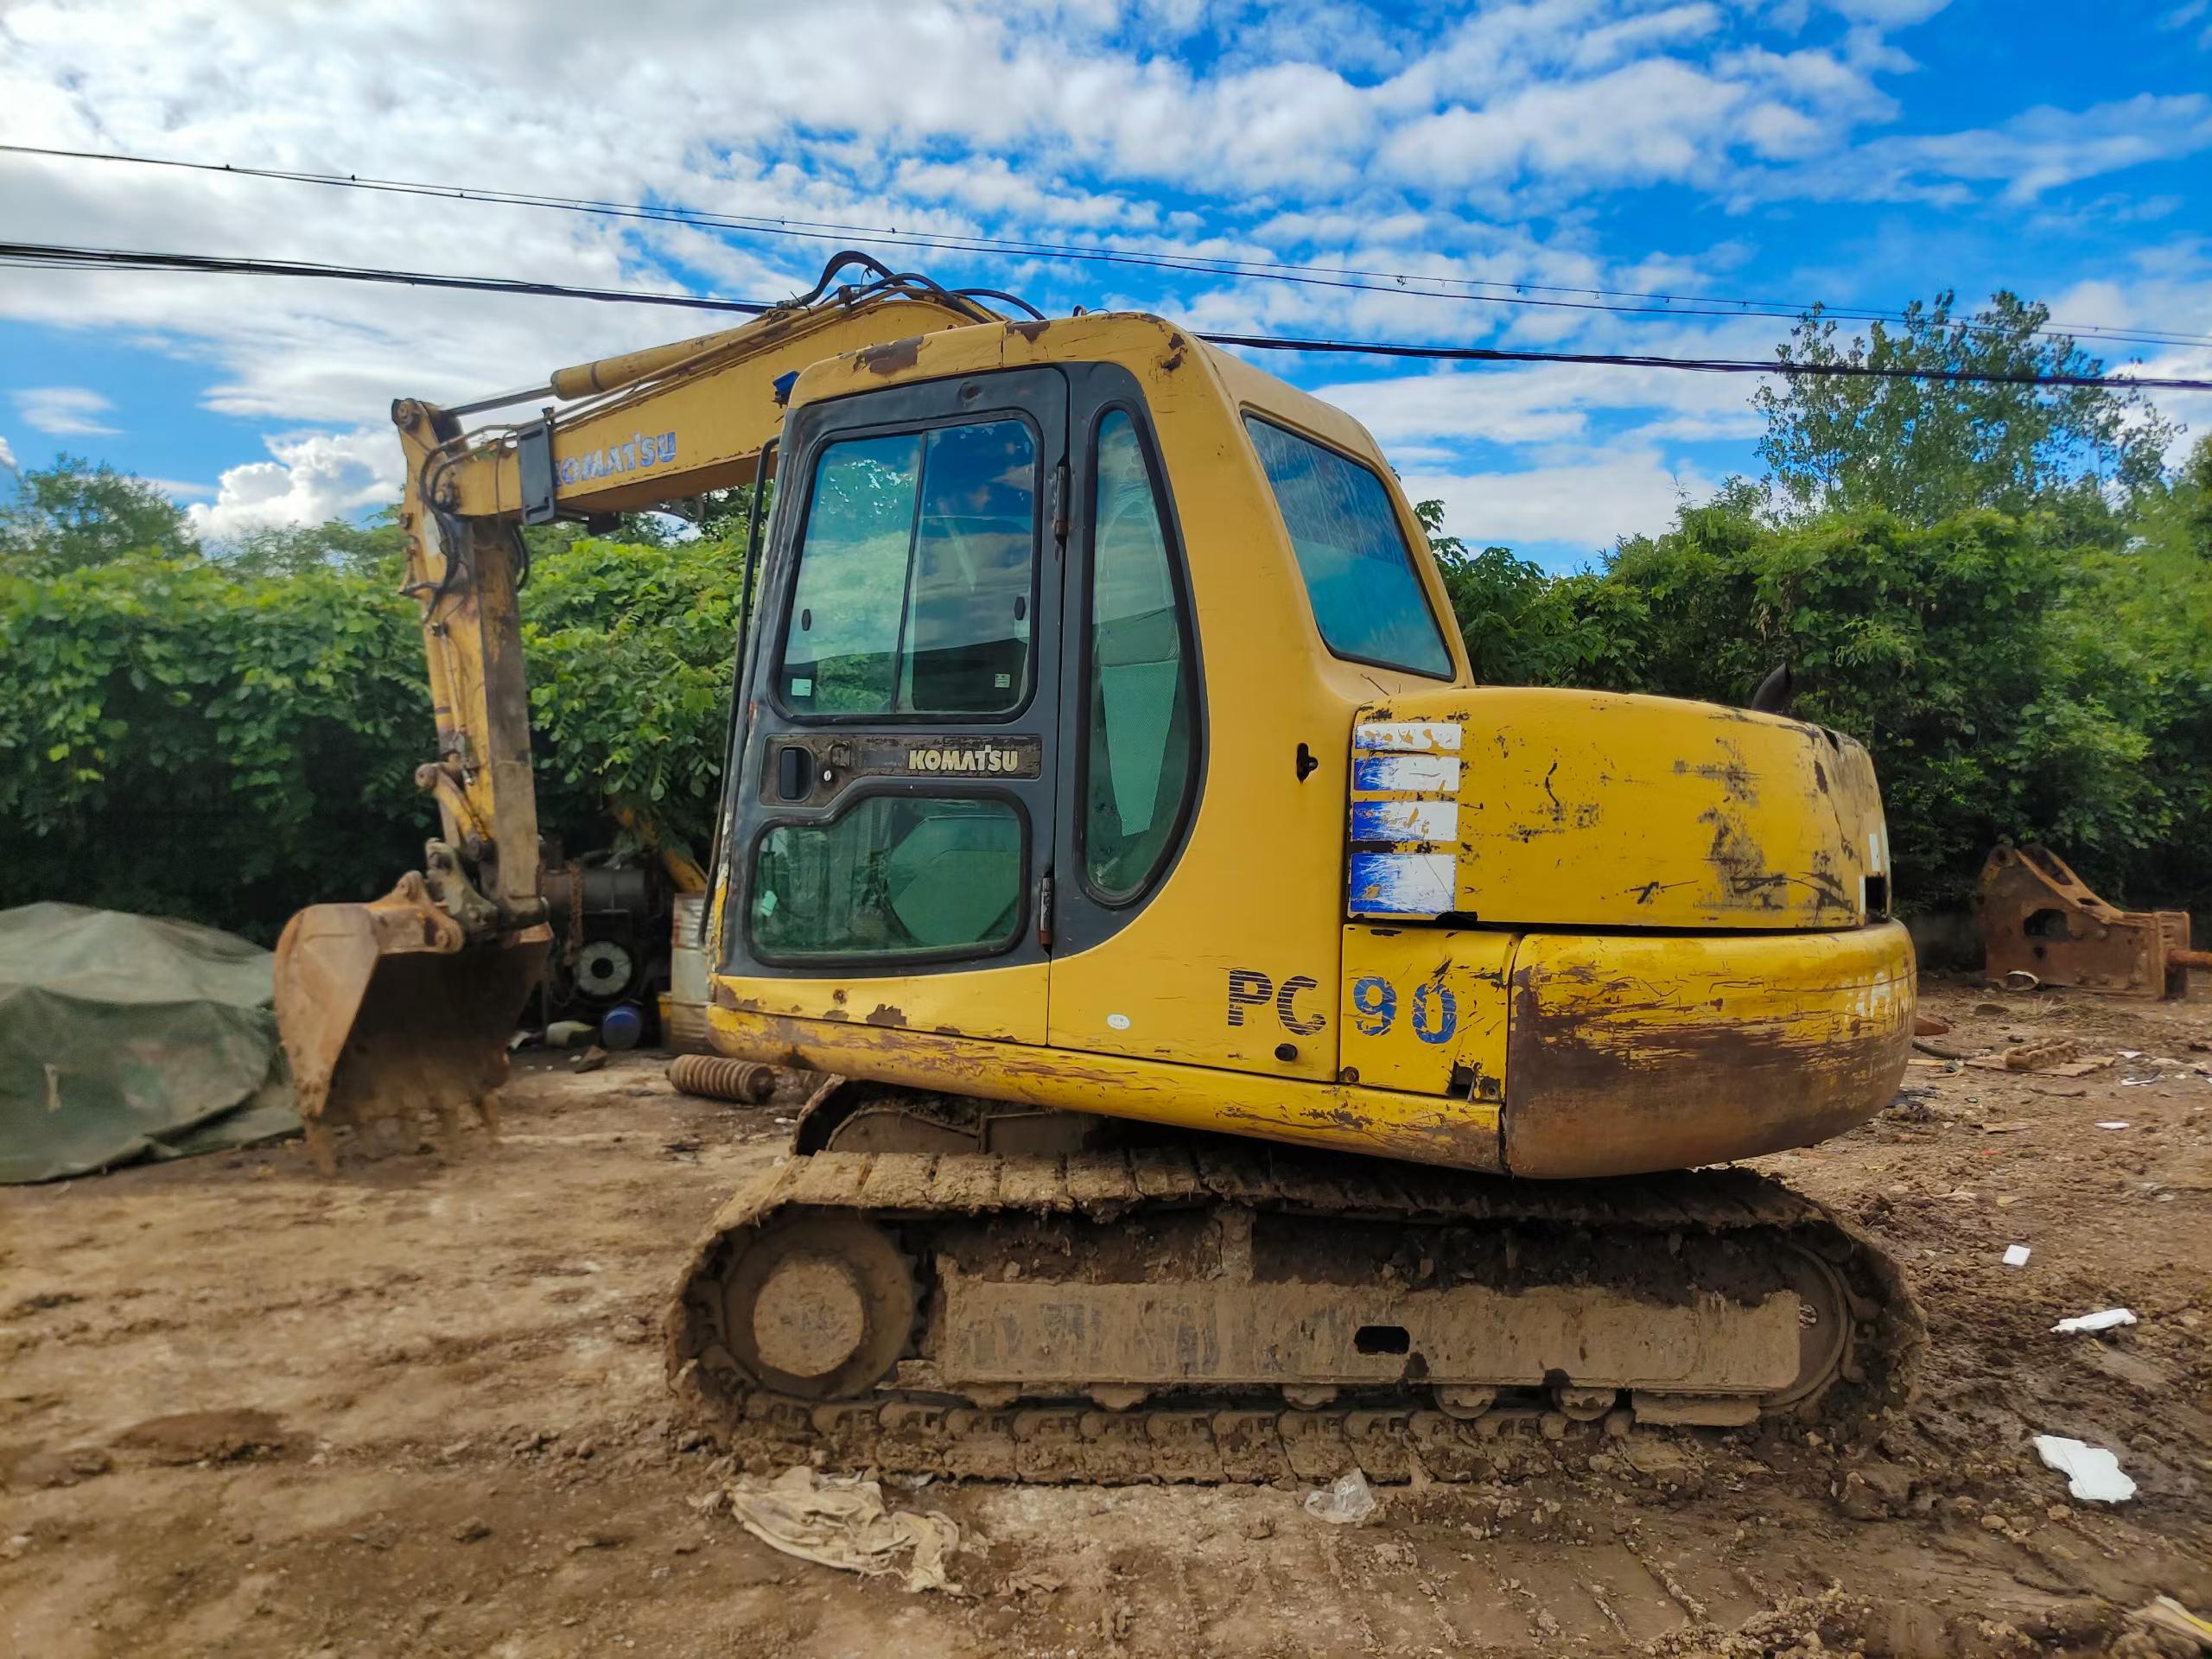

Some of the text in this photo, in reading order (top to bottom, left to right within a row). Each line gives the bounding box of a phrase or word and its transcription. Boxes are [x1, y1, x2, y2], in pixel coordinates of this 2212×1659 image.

[908, 744, 1019, 772] KOMATSU
[1228, 969, 1458, 1045] PC 90
